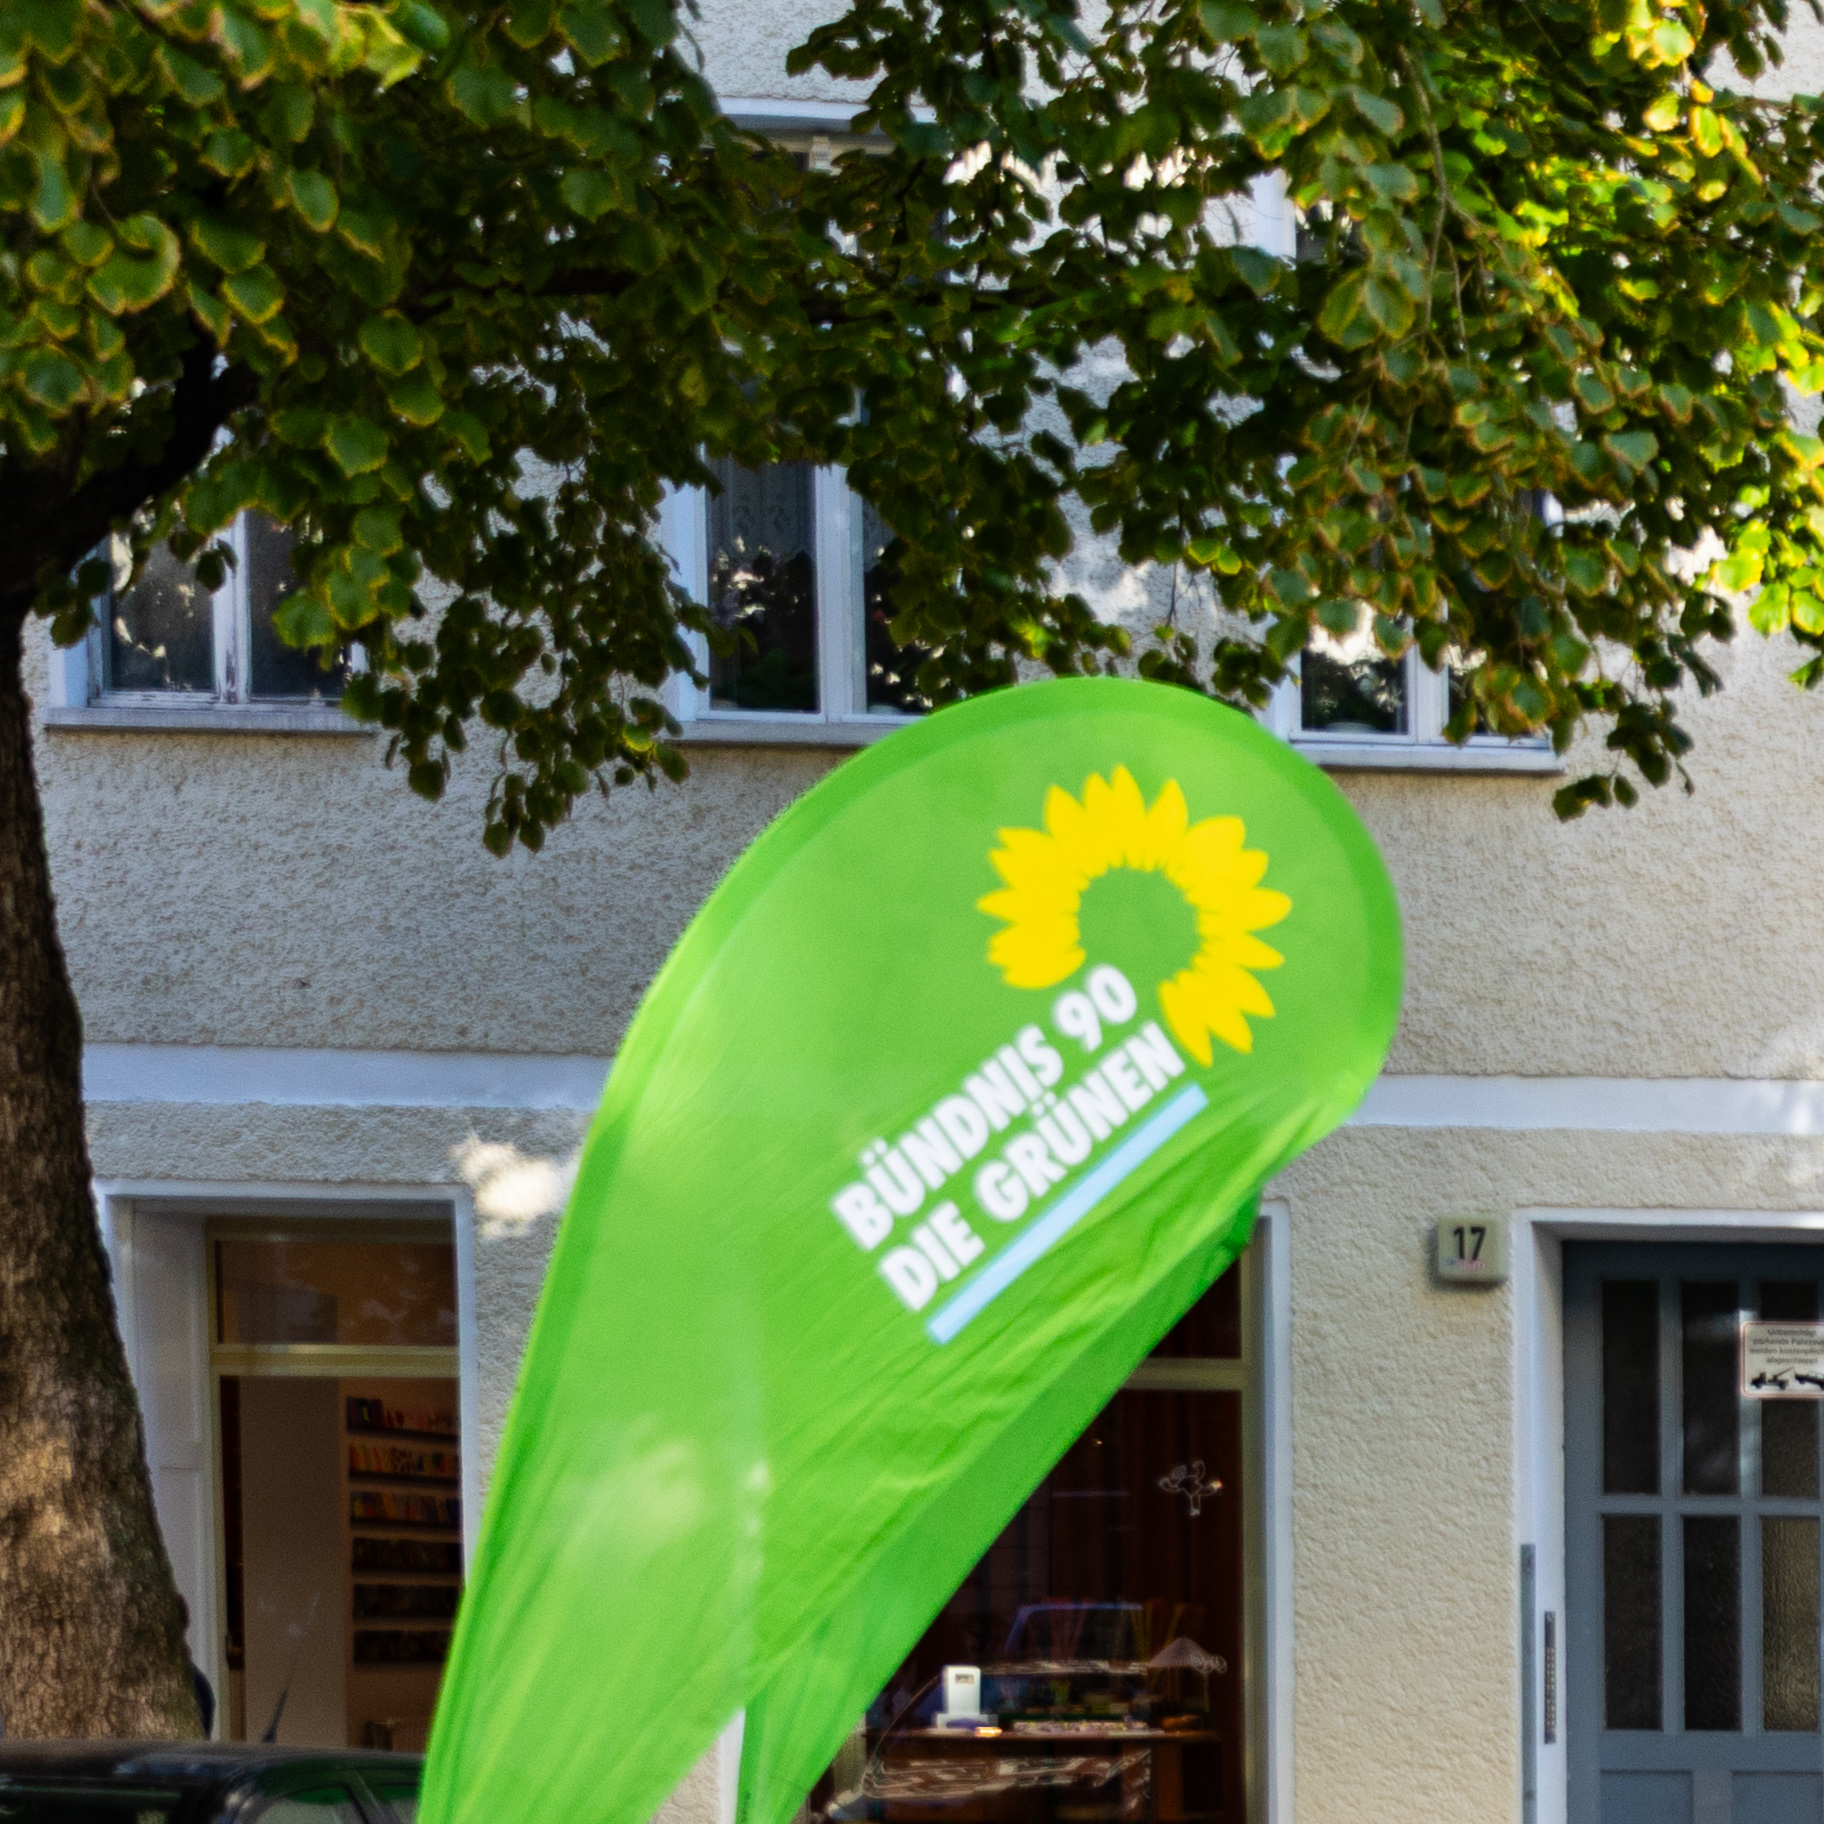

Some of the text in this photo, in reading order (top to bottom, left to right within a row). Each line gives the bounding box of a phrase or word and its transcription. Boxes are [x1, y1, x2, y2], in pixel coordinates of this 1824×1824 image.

[831, 964, 1138, 1252] BÜNDNIS 90
[877, 1021, 1186, 1312] DIE GRÜNEN
[1453, 1226, 1486, 1261] 17
